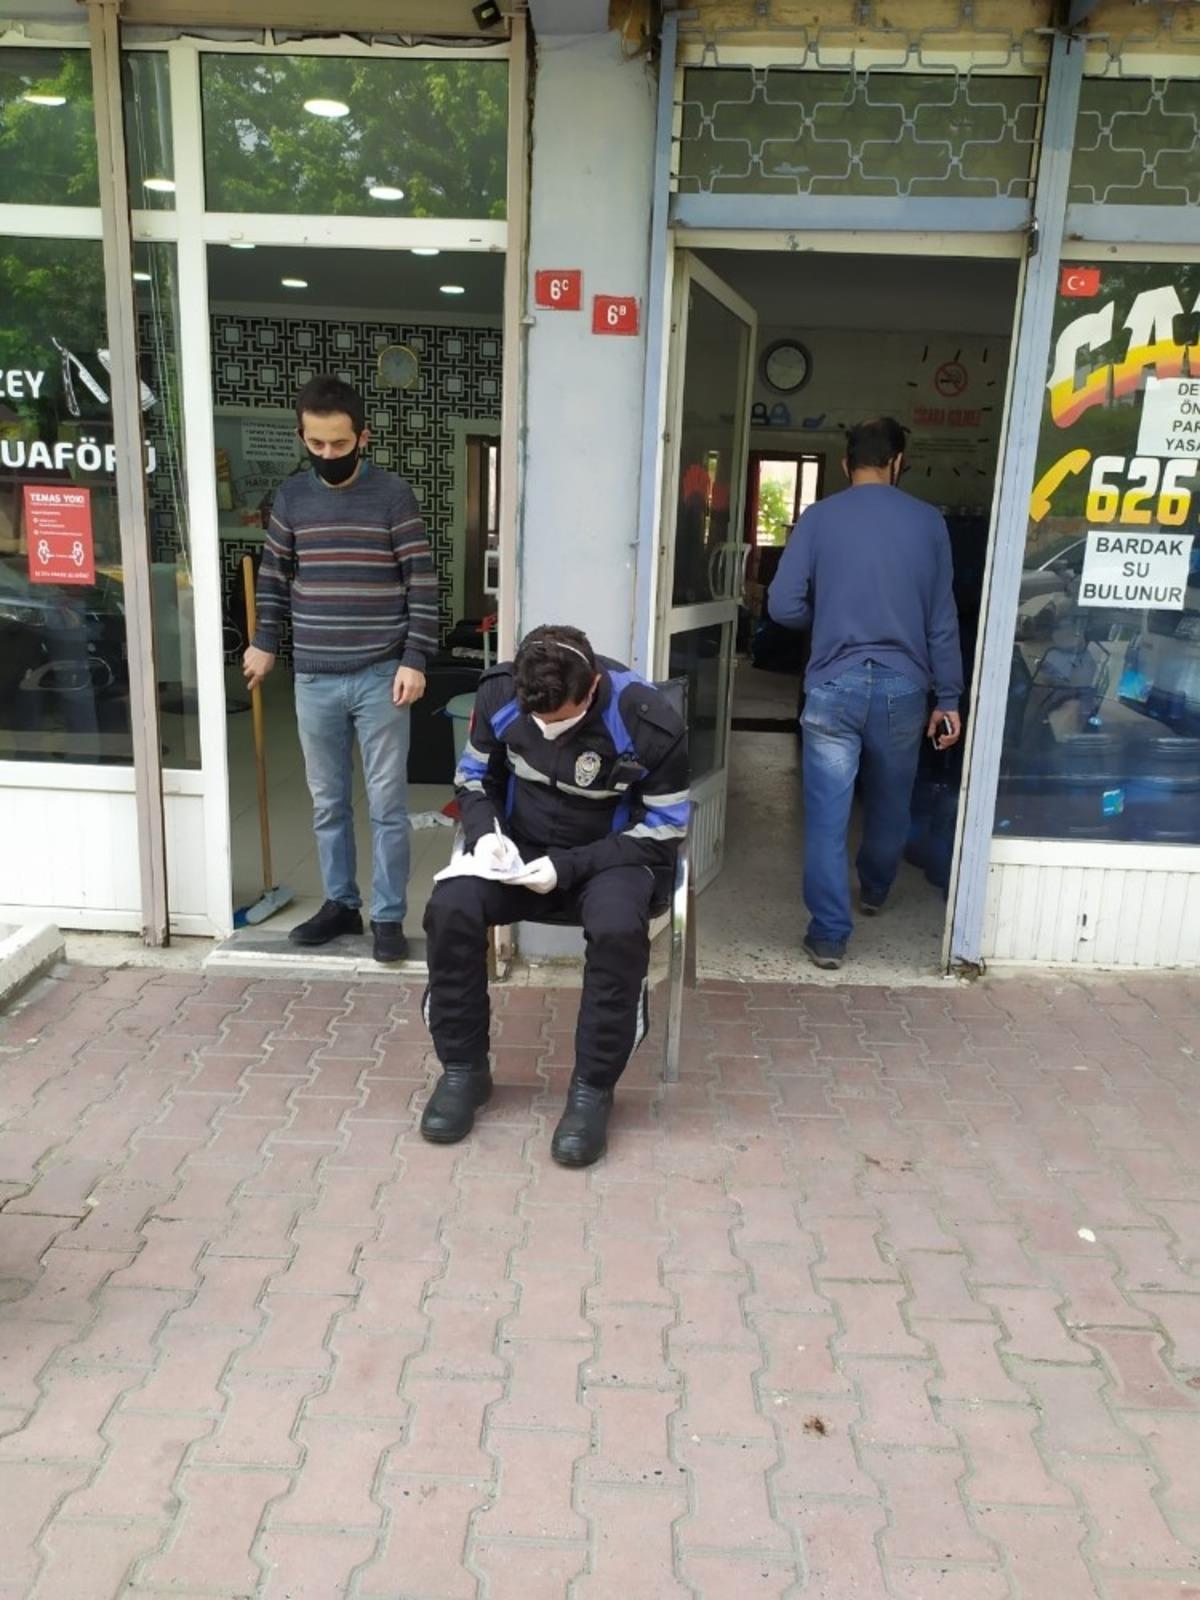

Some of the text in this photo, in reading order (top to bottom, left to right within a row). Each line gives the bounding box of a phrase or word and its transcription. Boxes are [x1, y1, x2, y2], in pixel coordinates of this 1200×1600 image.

[1046, 285, 1200, 428] CA
[30, 493, 61, 503] TEMAS
[1086, 456, 1198, 525] 626
[1096, 537, 1183, 556] BARDAK
[1122, 561, 1150, 578] SU
[1083, 583, 1182, 602] BULUNUR
